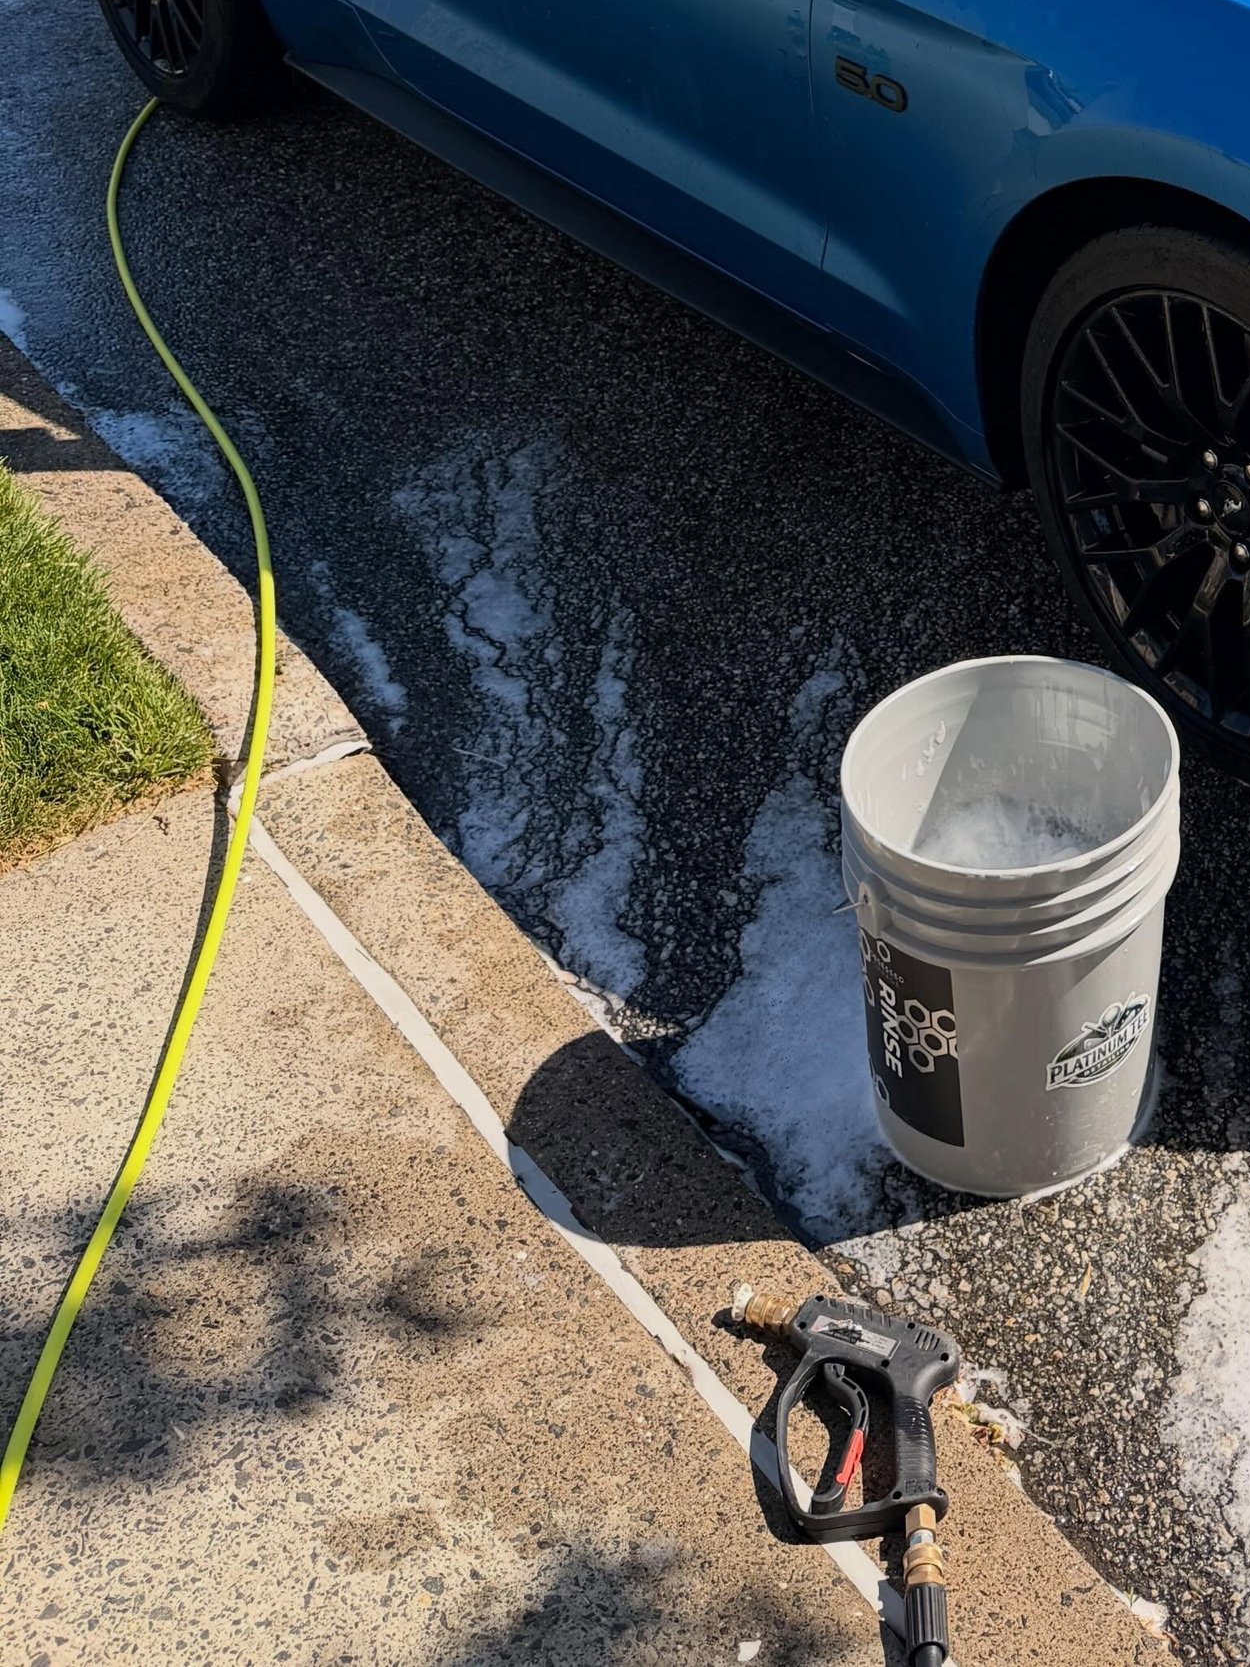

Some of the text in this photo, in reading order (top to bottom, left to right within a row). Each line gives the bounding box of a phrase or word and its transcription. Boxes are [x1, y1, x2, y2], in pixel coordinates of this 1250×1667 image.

[835, 55, 908, 113] 5.0
[878, 978, 903, 1079] RINSE
[1050, 1011, 1149, 1084] PLATINUM TEE
